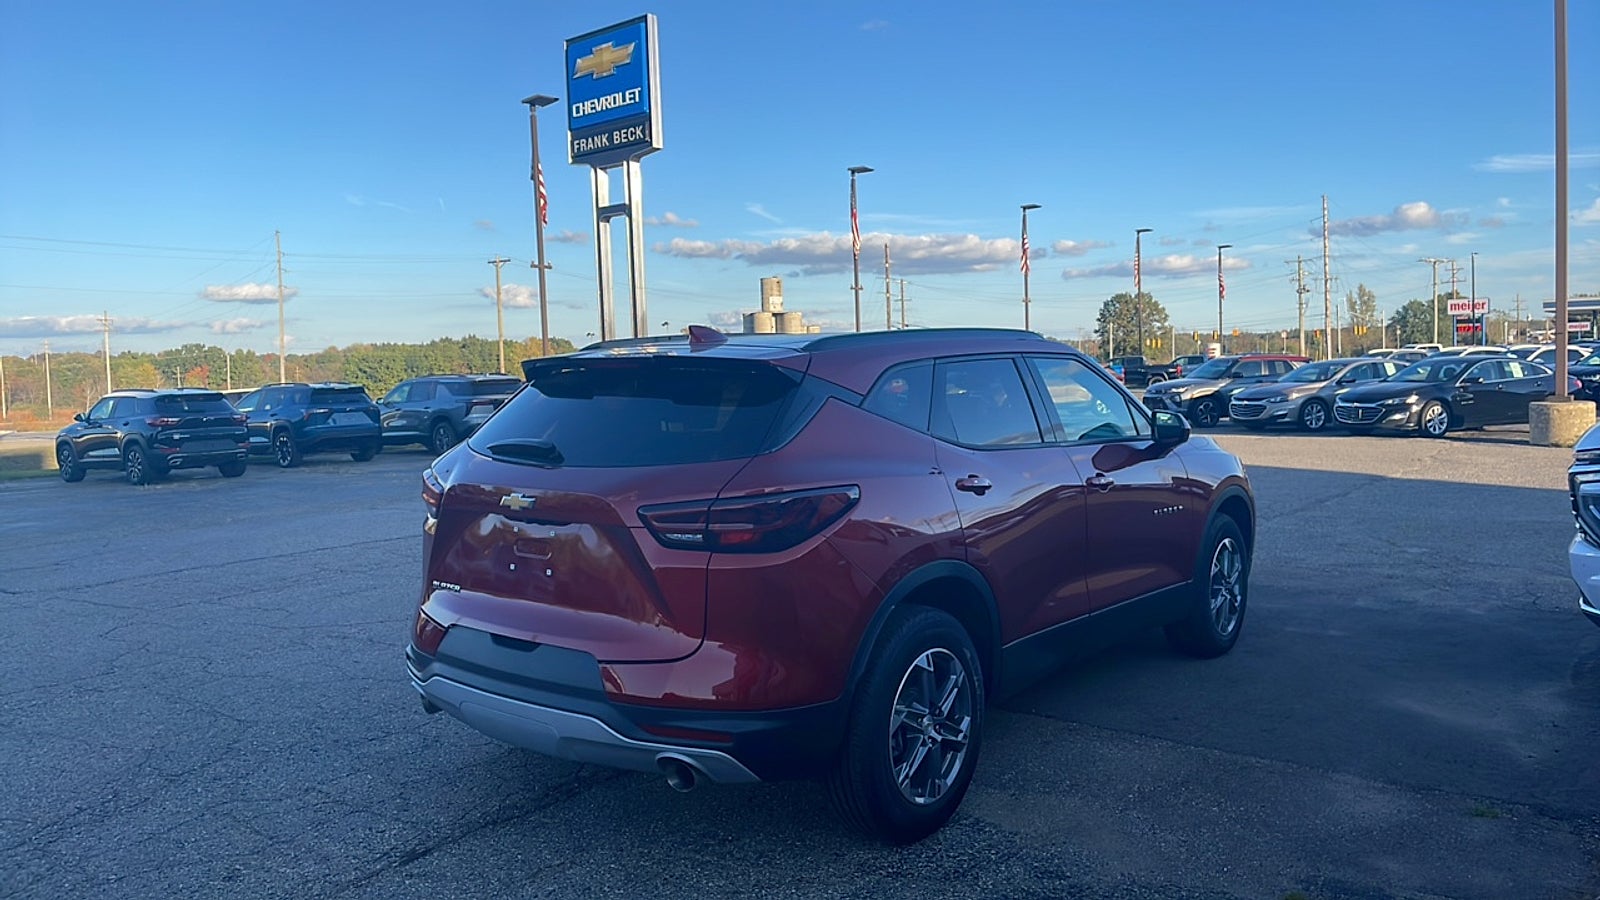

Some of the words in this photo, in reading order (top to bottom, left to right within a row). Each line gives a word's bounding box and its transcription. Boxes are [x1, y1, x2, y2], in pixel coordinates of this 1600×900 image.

[572, 88, 641, 117] CHEVROLET
[573, 133, 609, 153] FRANK
[613, 126, 643, 145] BECK
